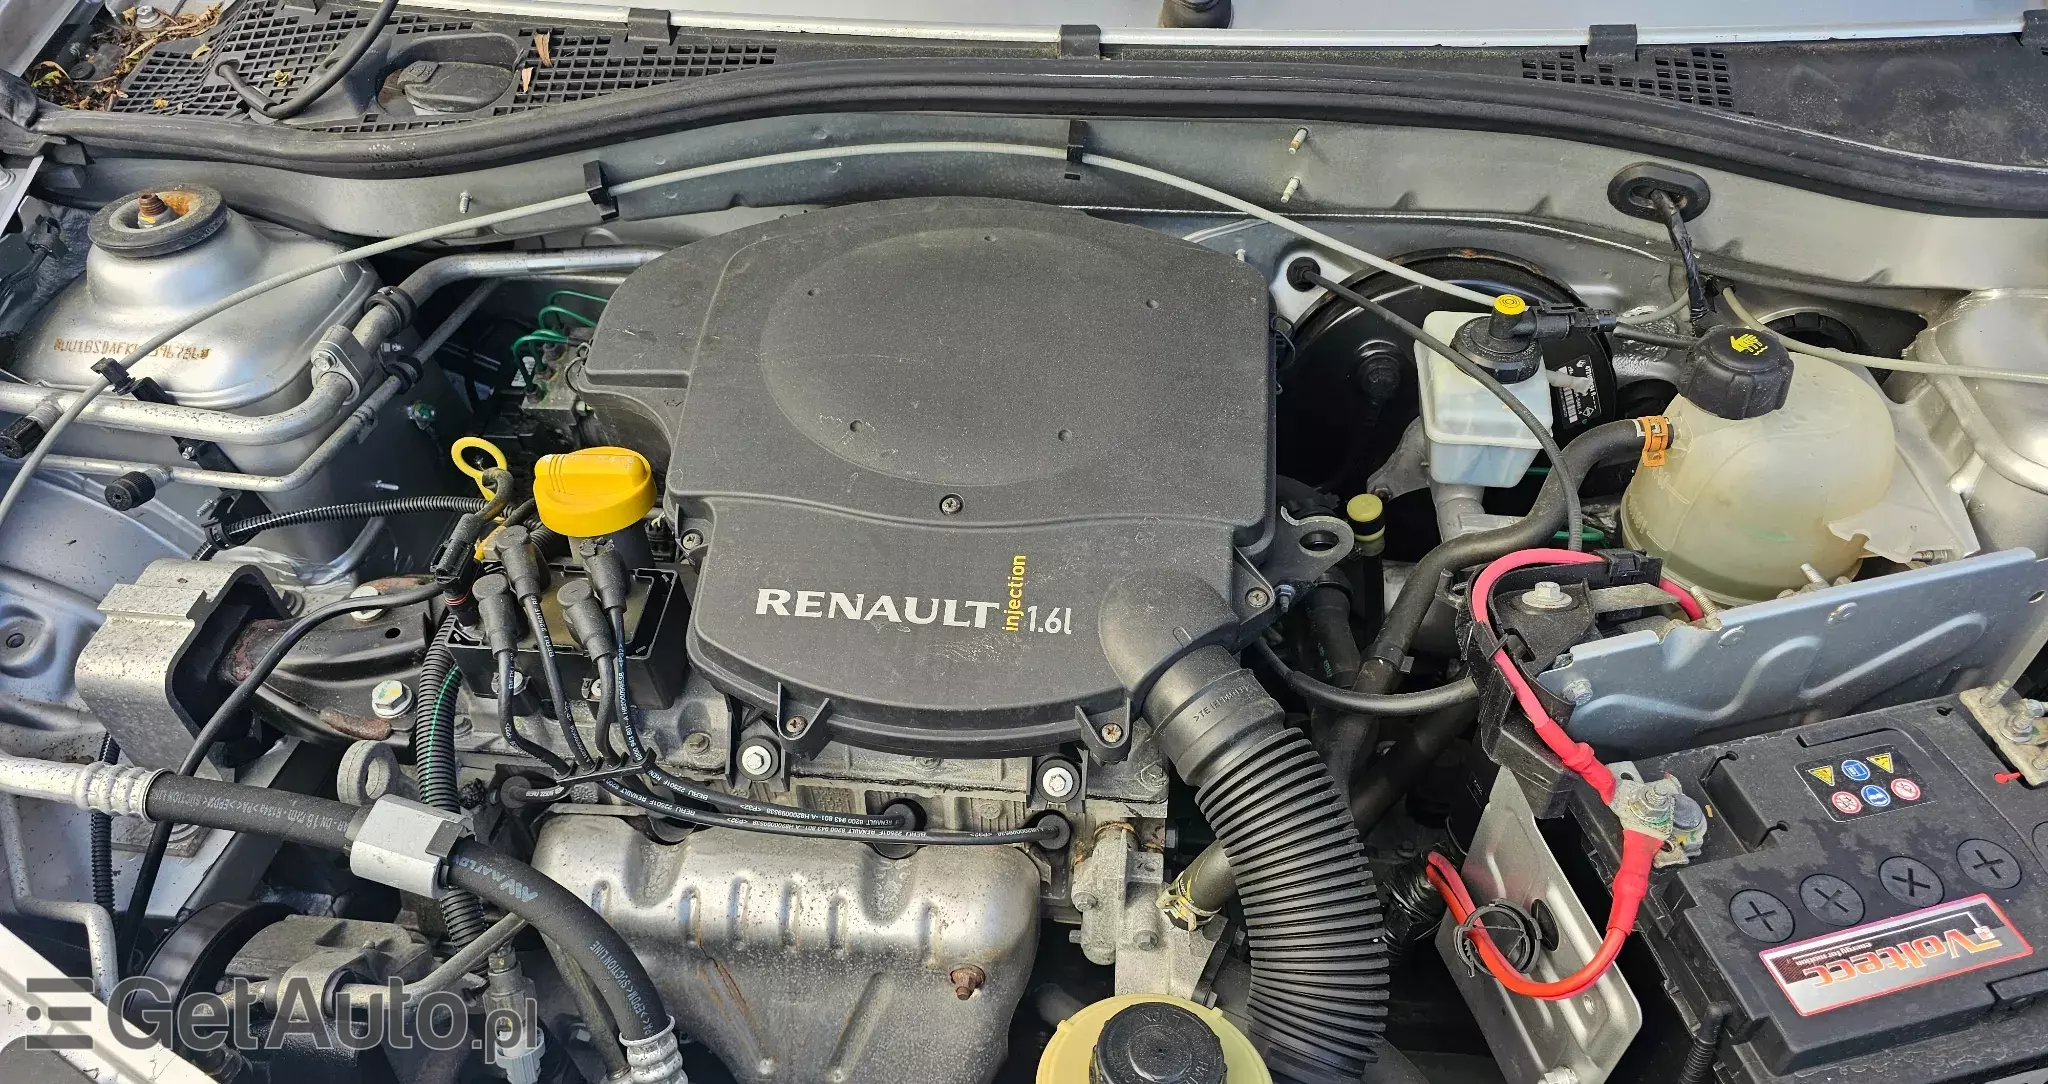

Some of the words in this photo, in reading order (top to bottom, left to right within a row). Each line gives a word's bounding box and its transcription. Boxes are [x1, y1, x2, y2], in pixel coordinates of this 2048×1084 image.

[755, 588, 999, 628] RENAULT
[1001, 555, 1027, 632] injection
[589, 940, 609, 961] LINE
[1803, 928, 2004, 988] Voltecc
[603, 957, 632, 989] SUCTION
